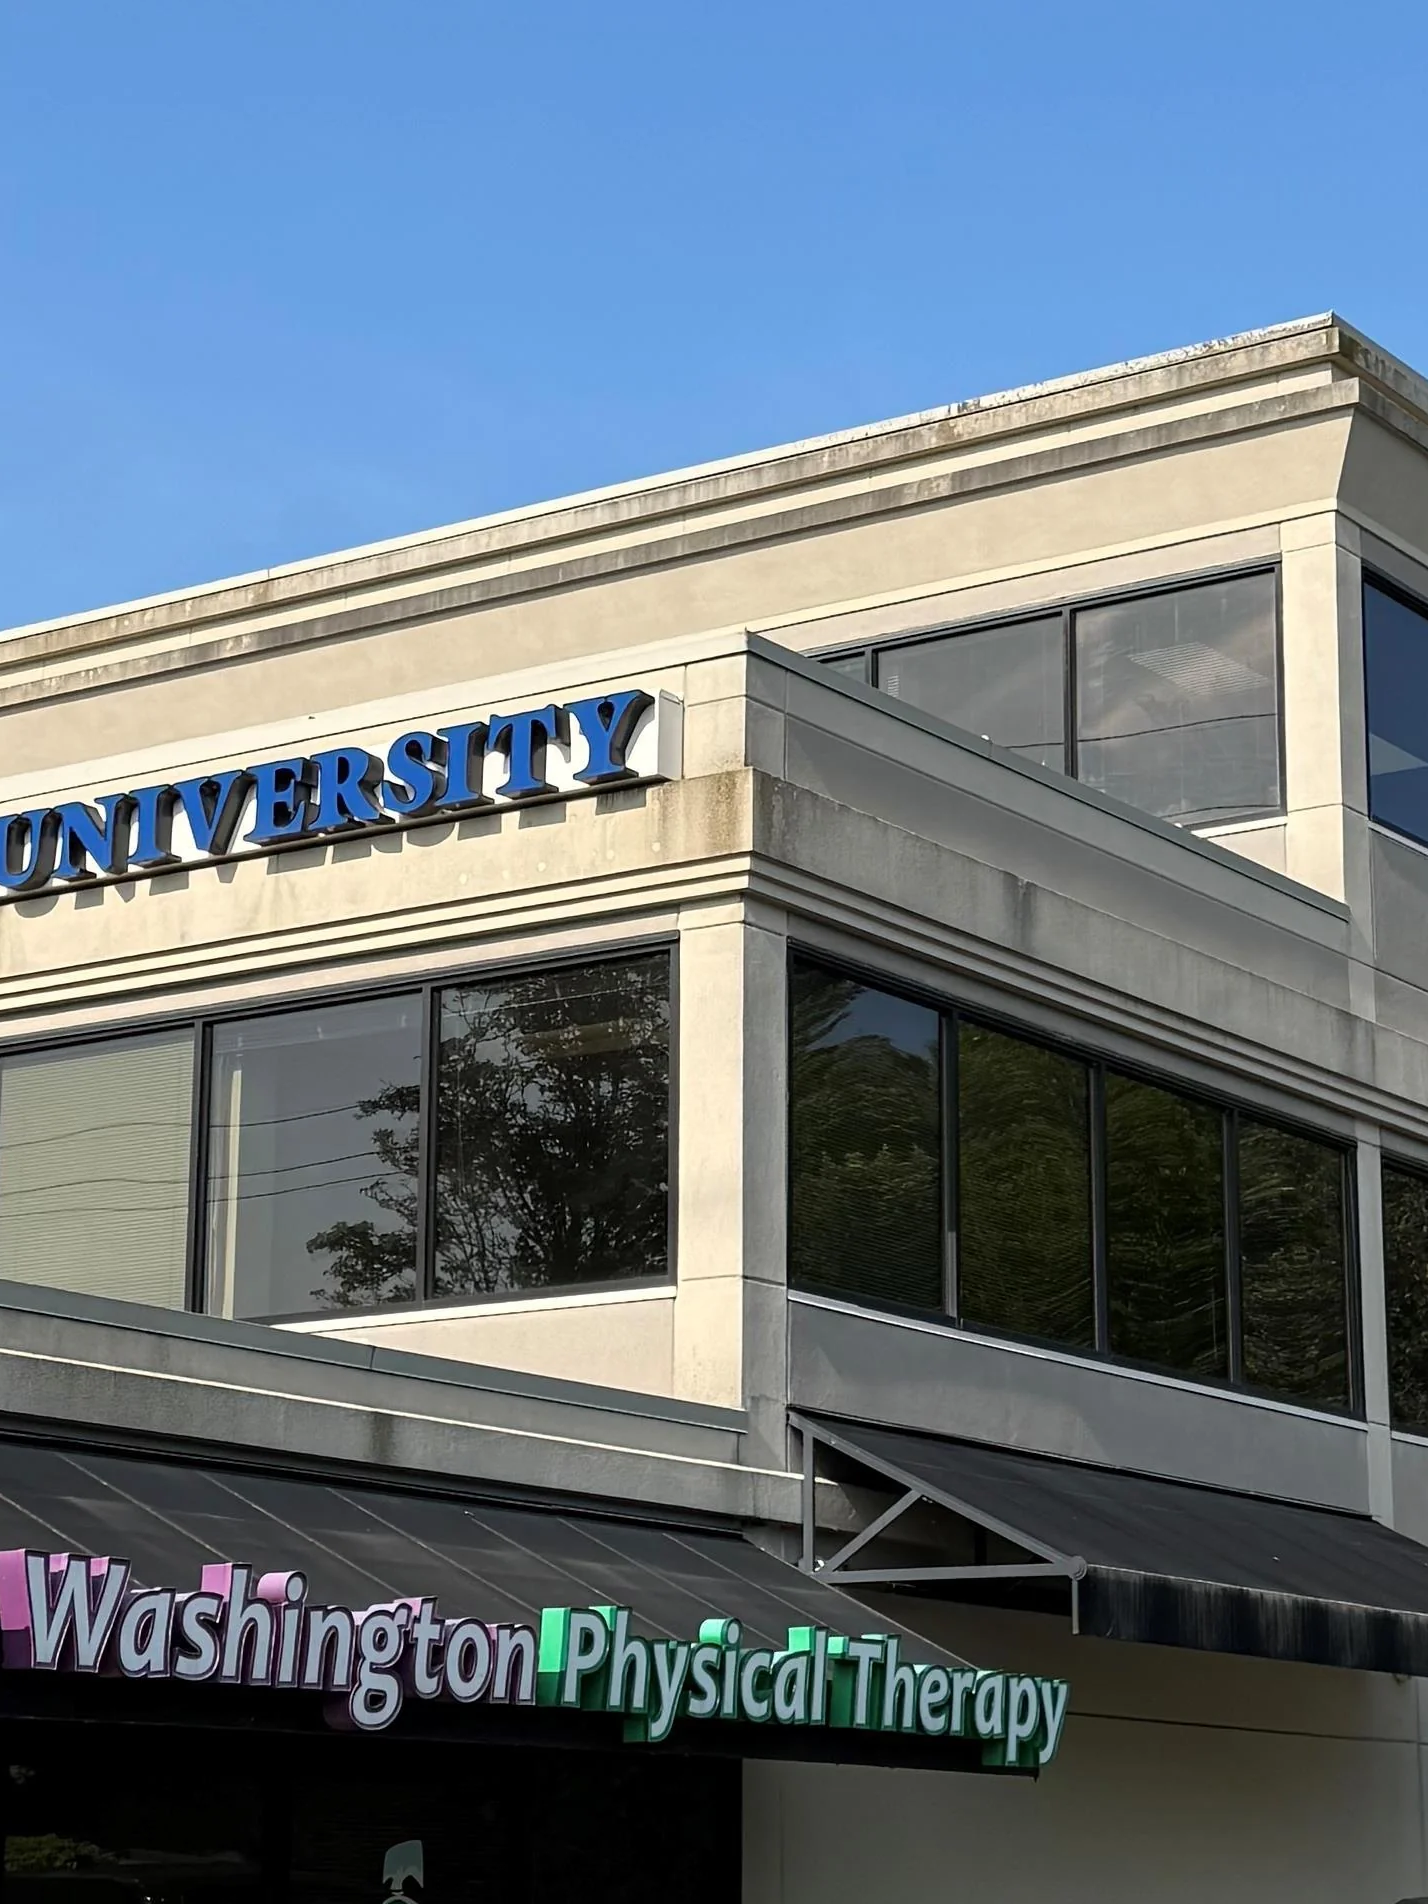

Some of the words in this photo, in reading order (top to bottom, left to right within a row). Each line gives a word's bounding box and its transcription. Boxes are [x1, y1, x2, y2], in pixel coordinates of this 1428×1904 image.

[8, 1549, 538, 1730] Washington
[554, 1606, 827, 1742] Physical
[844, 1634, 1069, 1766] Therapy
